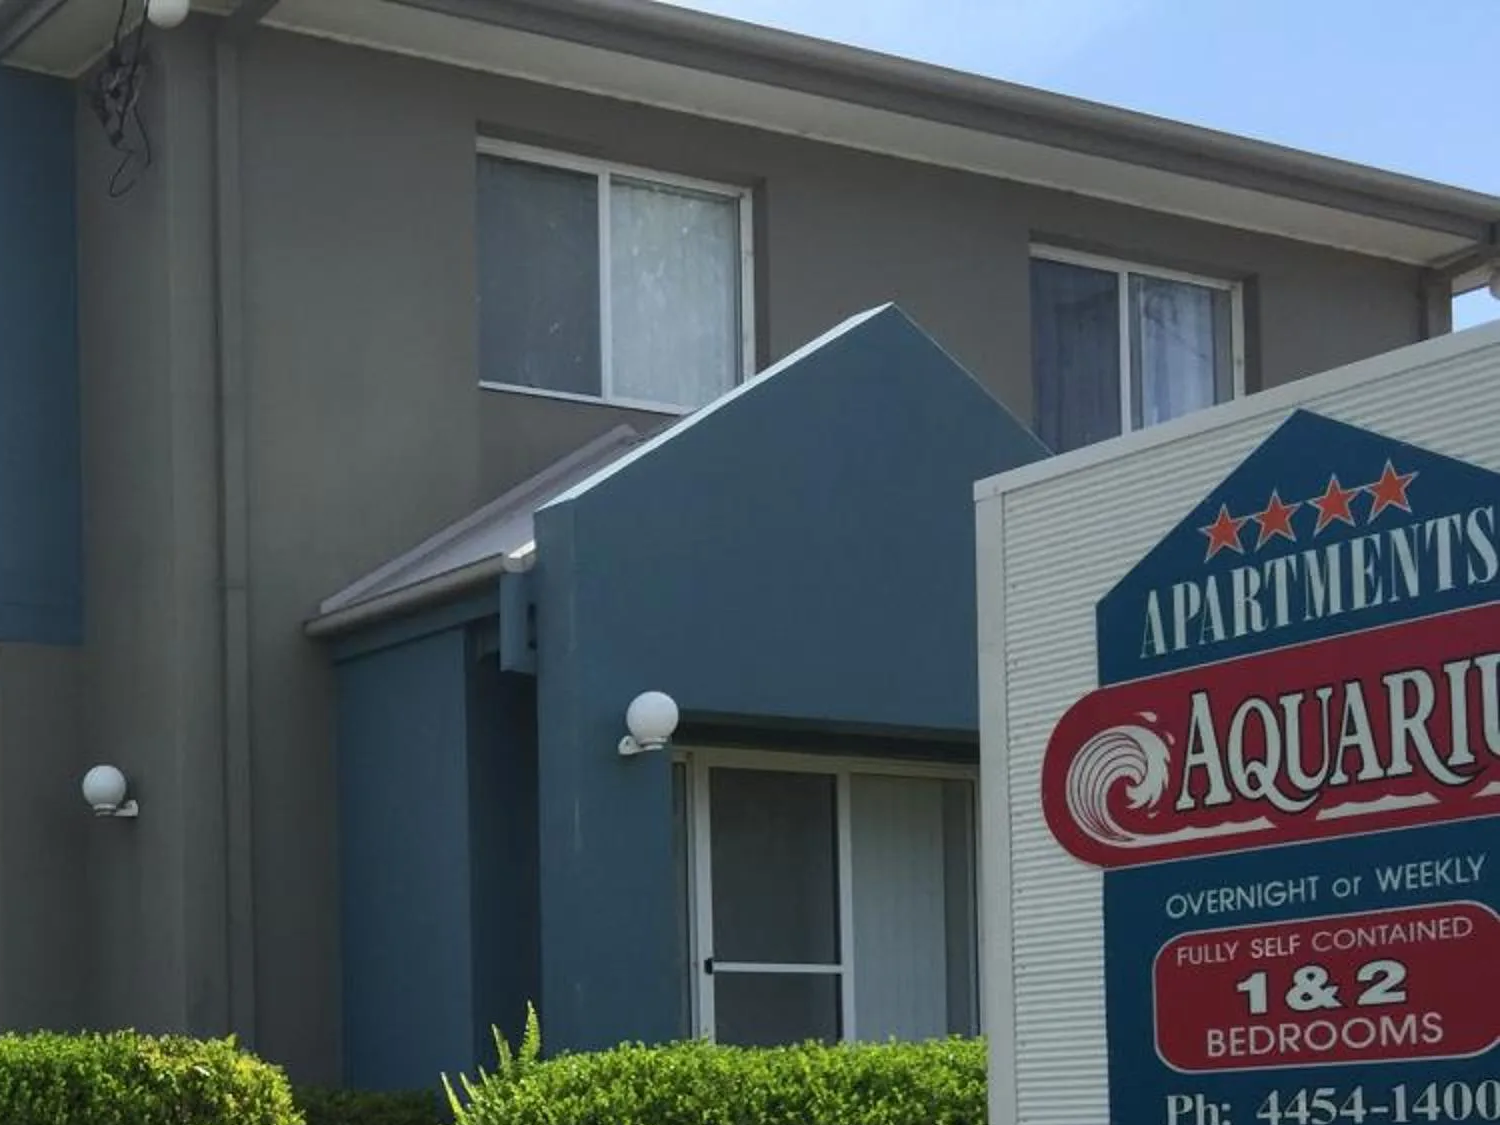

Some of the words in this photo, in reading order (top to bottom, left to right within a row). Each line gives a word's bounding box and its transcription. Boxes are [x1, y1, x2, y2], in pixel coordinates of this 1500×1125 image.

[1140, 505, 1499, 658] APARTMENTS
[1165, 876, 1320, 919] OVERNIGHT
[1332, 877, 1362, 898] or
[1375, 855, 1486, 893] WEEKLY
[1177, 940, 1240, 966] FULLY
[1251, 934, 1300, 960] SELF
[1311, 916, 1473, 953] CONTAINED
[1207, 1012, 1444, 1058] BEDROOMS
